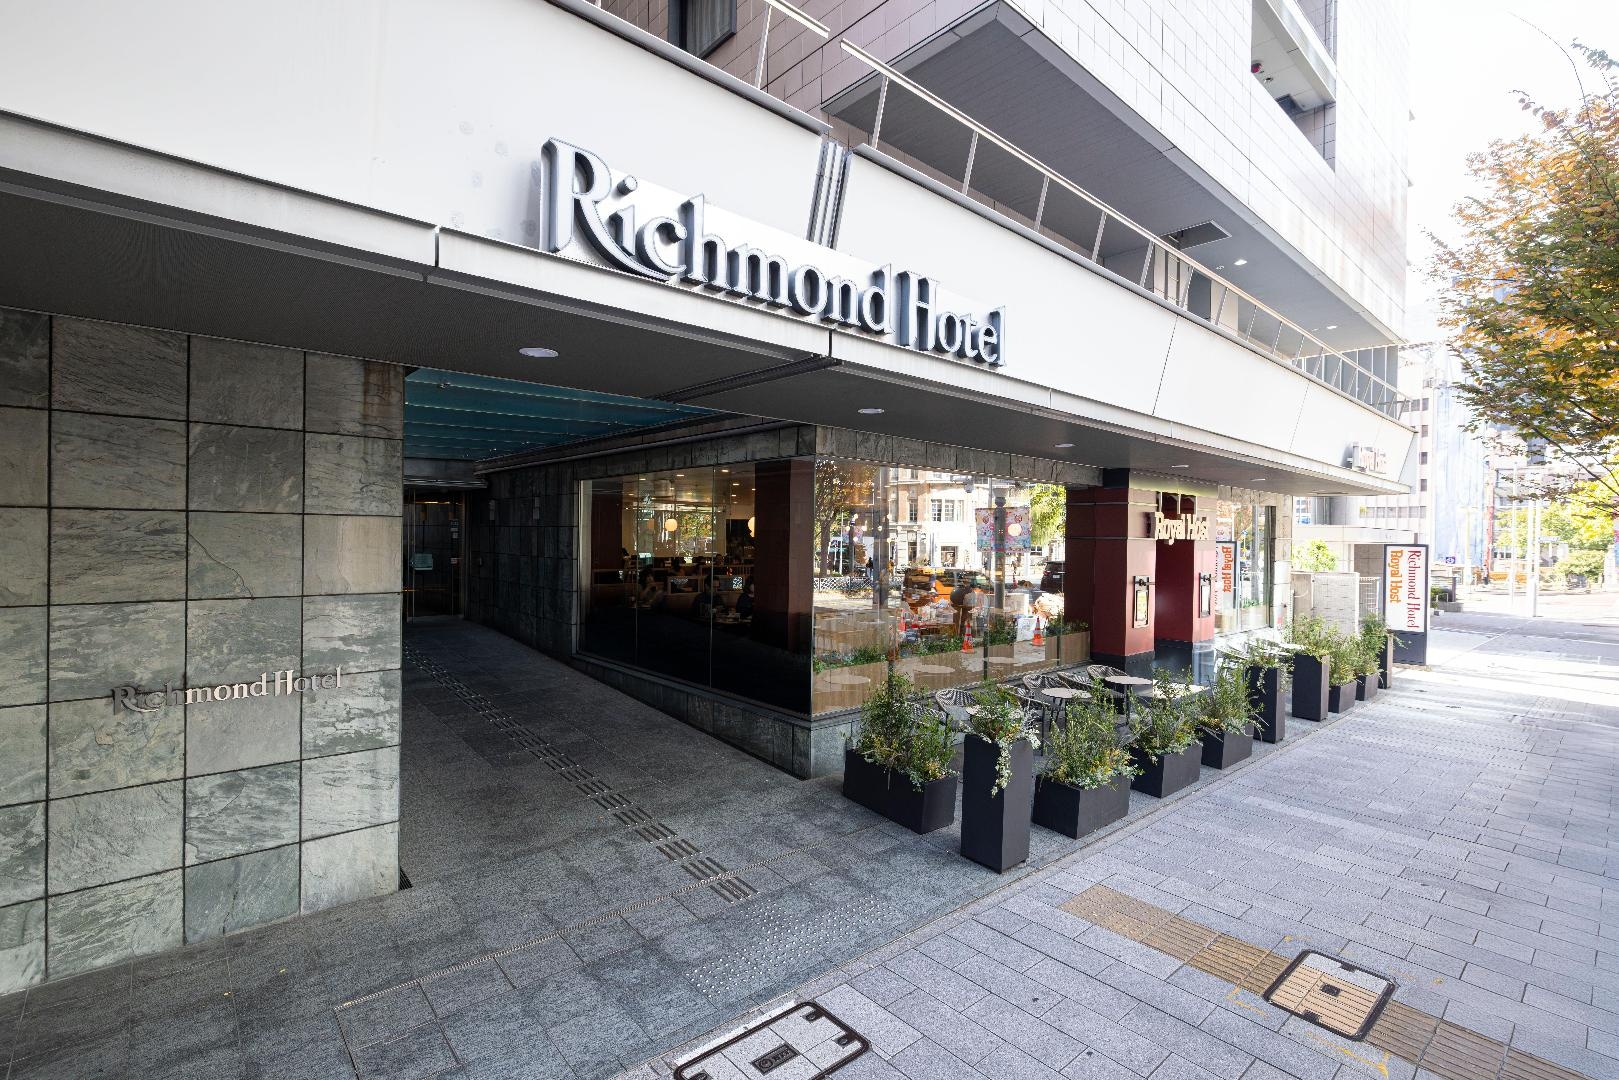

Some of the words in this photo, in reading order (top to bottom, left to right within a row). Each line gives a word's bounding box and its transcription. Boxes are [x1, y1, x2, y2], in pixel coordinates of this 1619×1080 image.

[540, 136, 894, 335] Richmond
[896, 270, 1007, 367] Hotel
[1155, 511, 1186, 545] Royal
[1388, 549, 1404, 578] Royal
[1407, 550, 1422, 600] Richmond
[1389, 580, 1403, 604] Host
[1406, 602, 1421, 629] Hotel
[111, 673, 269, 715] Richmond
[272, 664, 342, 698] Hotel
